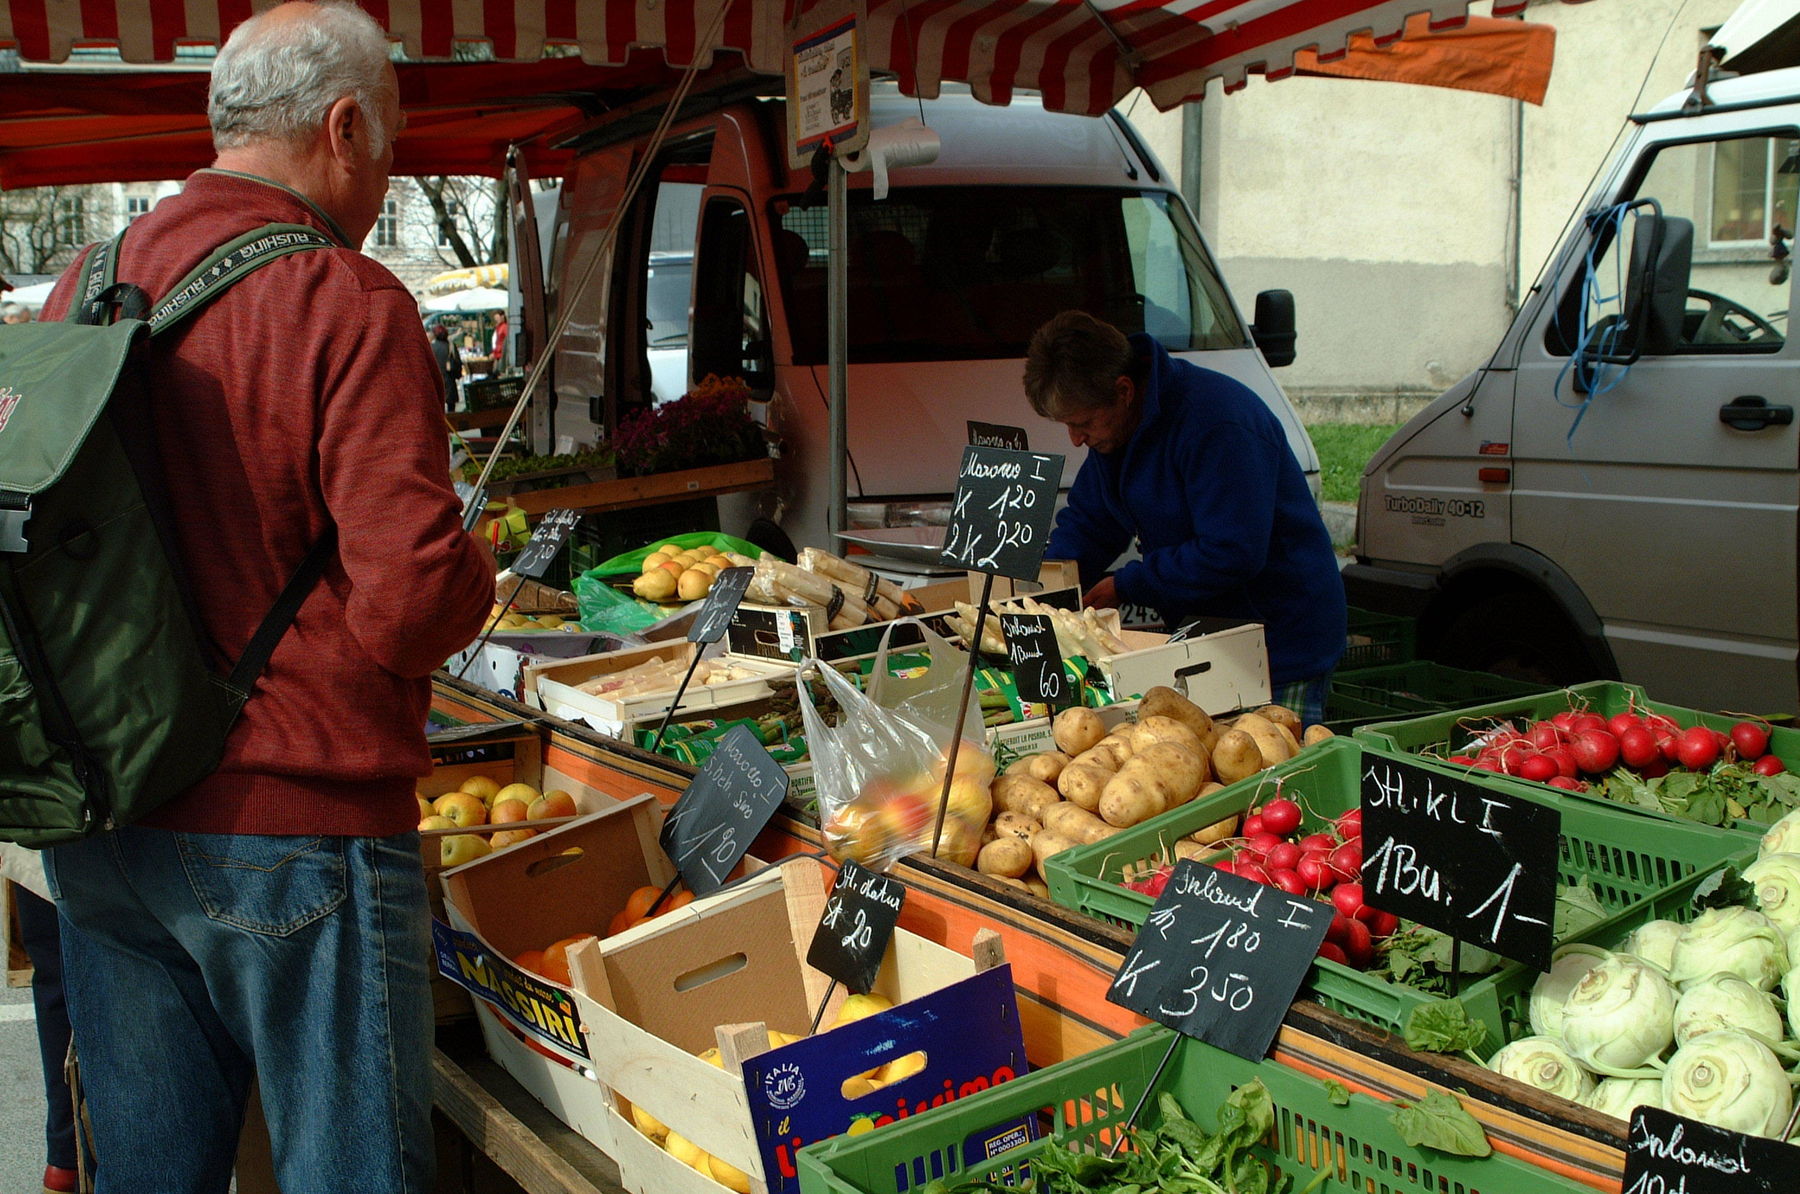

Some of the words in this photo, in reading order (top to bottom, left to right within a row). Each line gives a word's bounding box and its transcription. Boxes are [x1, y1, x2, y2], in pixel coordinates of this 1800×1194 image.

[1384, 494, 1446, 516] TurboDaily
[1039, 660, 1060, 698] 60
[841, 908, 872, 950] 20
[1113, 949, 1162, 998] K
[455, 951, 583, 1050] MASSIRI
[765, 1062, 801, 1086] ITALIA
[777, 1115, 791, 1137] il
